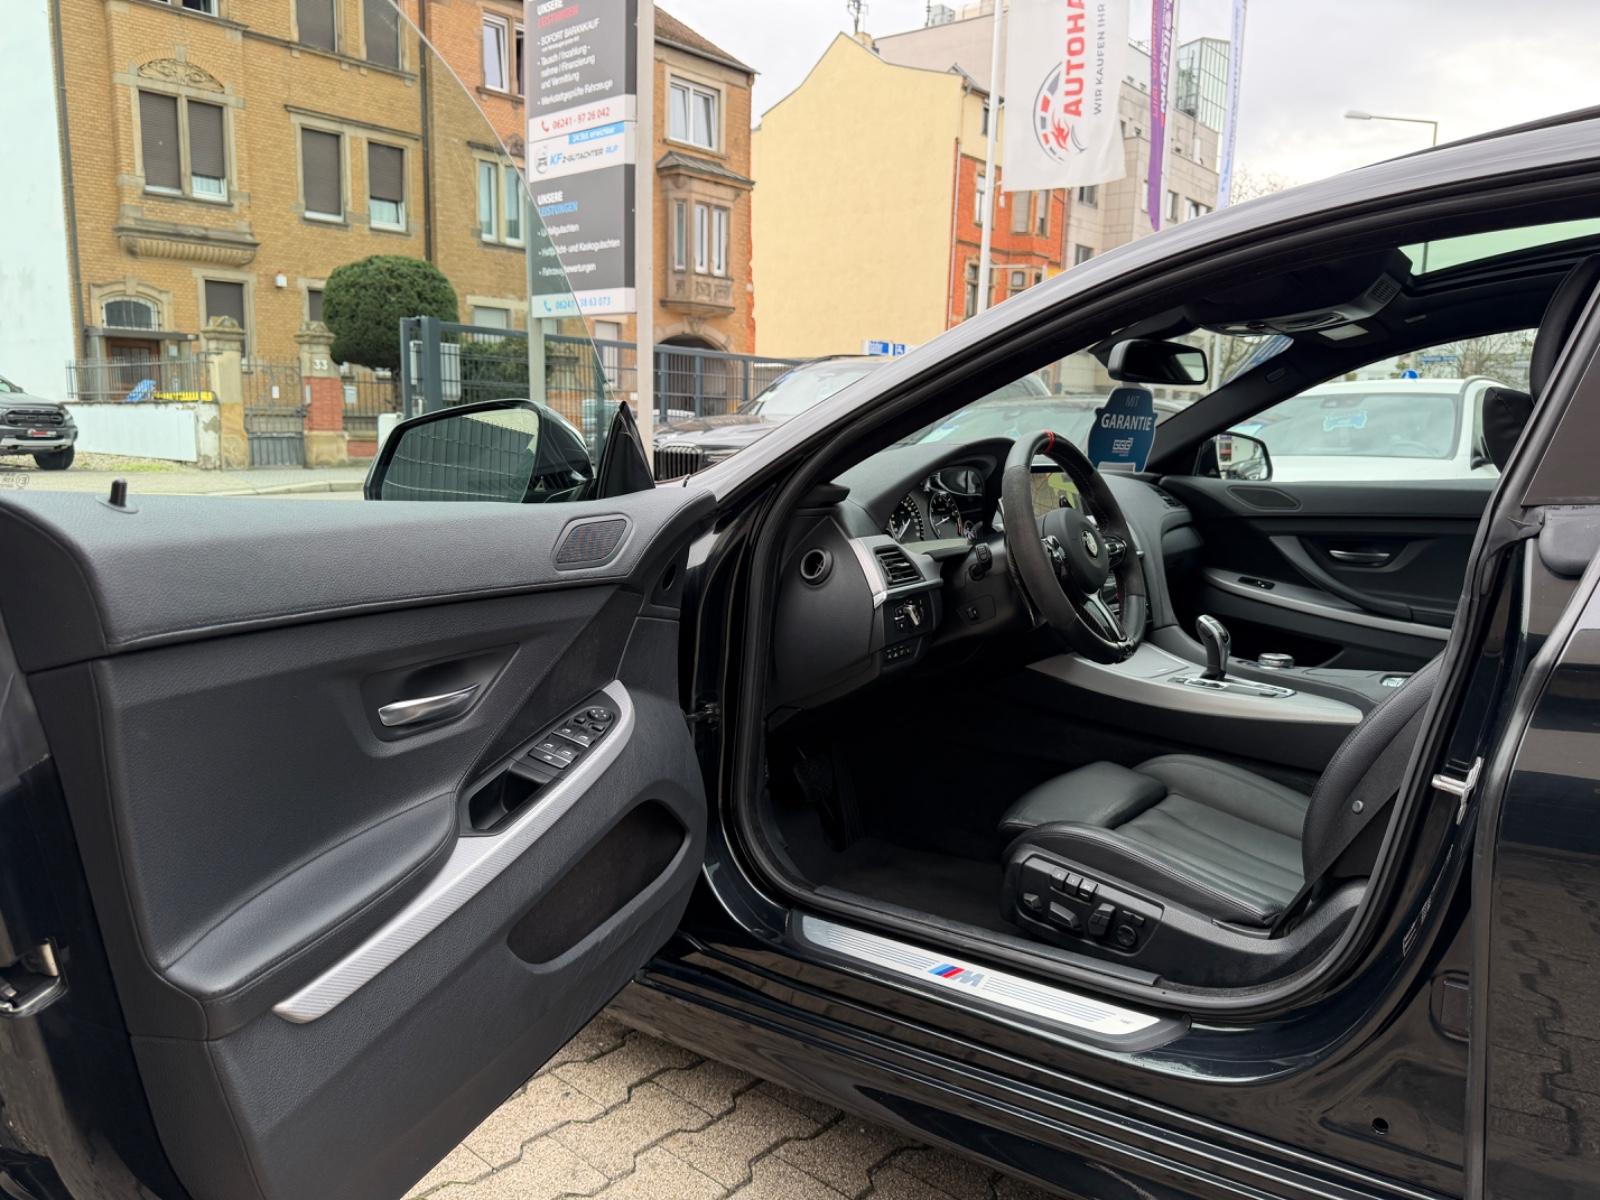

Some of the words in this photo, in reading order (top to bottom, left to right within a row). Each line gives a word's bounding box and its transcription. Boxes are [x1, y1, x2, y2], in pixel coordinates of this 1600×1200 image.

[1097, 4, 1106, 28] IHR
[1095, 31, 1106, 85] KAUFEN
[1093, 89, 1103, 115] WIR
[312, 359, 328, 370] 33
[1101, 414, 1153, 431] GARANTIE
